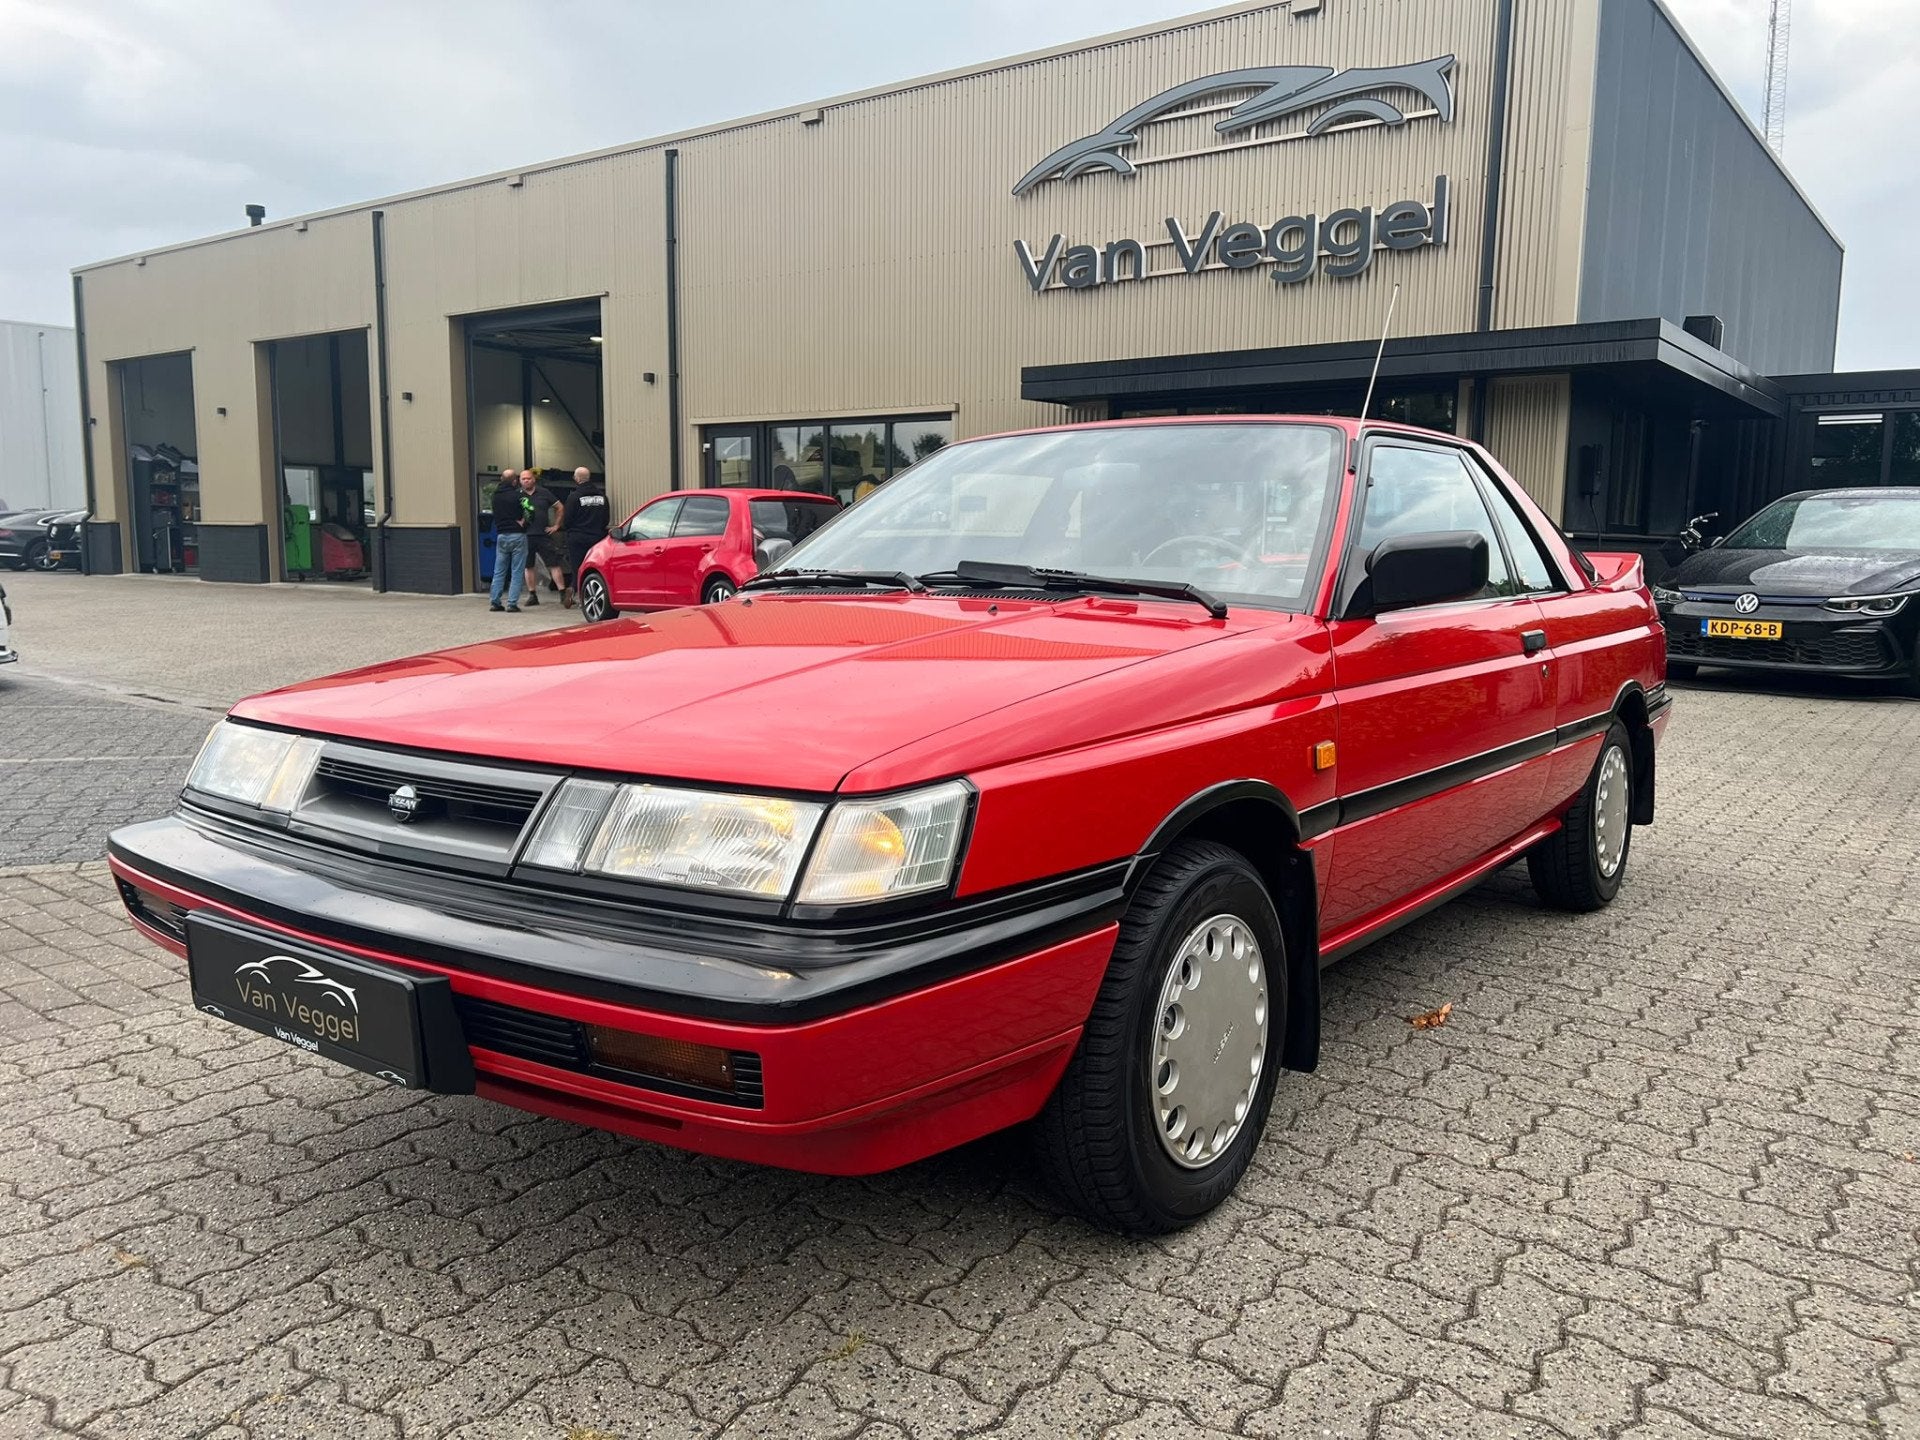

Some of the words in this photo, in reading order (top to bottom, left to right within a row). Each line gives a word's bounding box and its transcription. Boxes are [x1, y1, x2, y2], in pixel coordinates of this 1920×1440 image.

[1013, 233, 1147, 291] Van
[1165, 174, 1451, 283] Veggel
[1710, 621, 1778, 636] KDP-68-B
[236, 978, 277, 1013] Van
[282, 992, 359, 1042] Veggel
[274, 1026, 291, 1041] Van
[290, 1031, 319, 1051] Veggel
